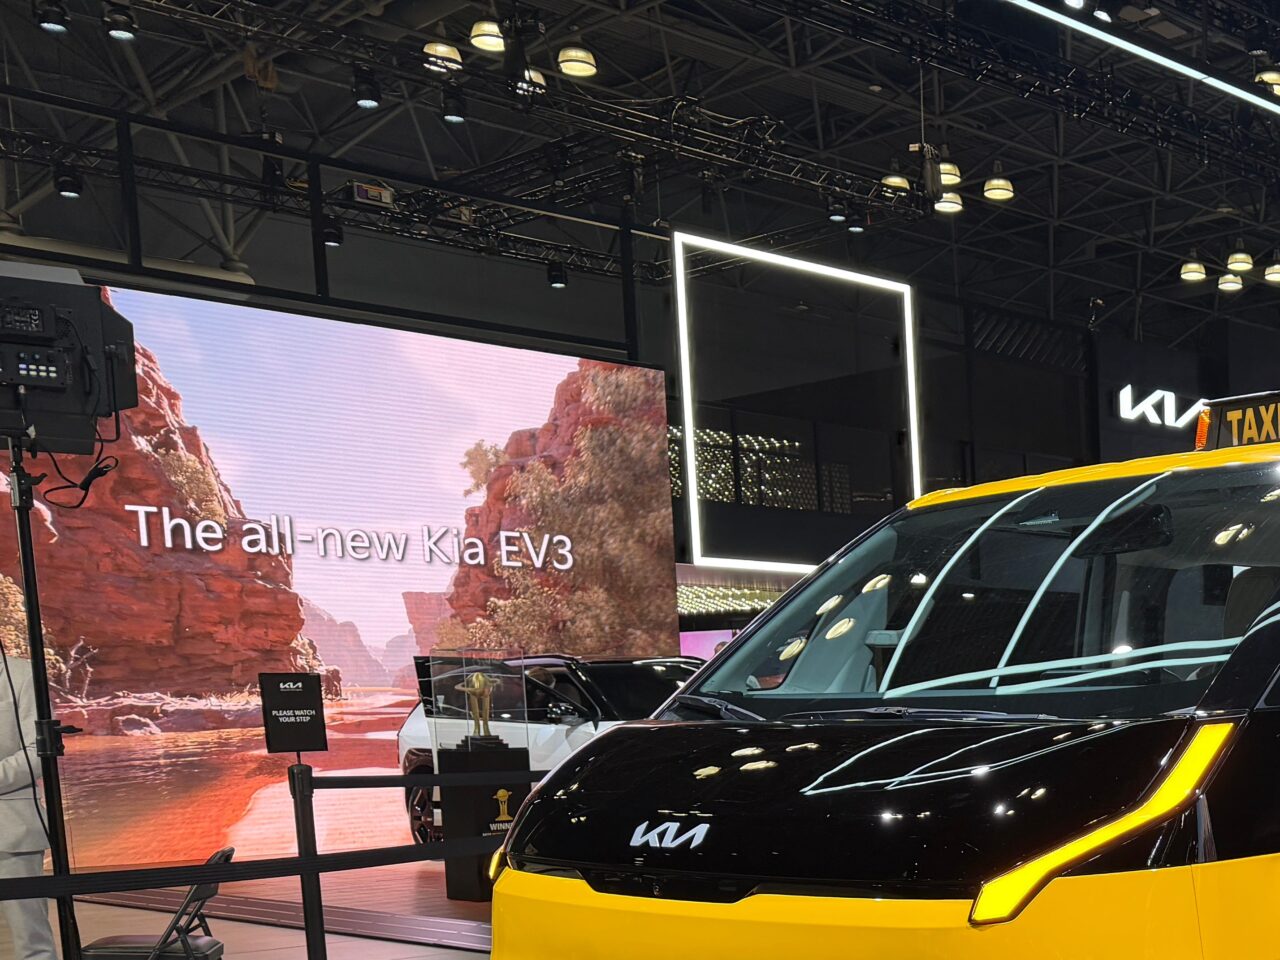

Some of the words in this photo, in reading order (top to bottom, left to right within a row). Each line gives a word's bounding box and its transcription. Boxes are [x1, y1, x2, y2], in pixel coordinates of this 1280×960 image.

[124, 503, 224, 552] The
[241, 512, 408, 562] all-new
[421, 524, 486, 566] Kia
[499, 529, 574, 571] EV3
[489, 822, 513, 831] WINN
[629, 820, 710, 849] KIA
